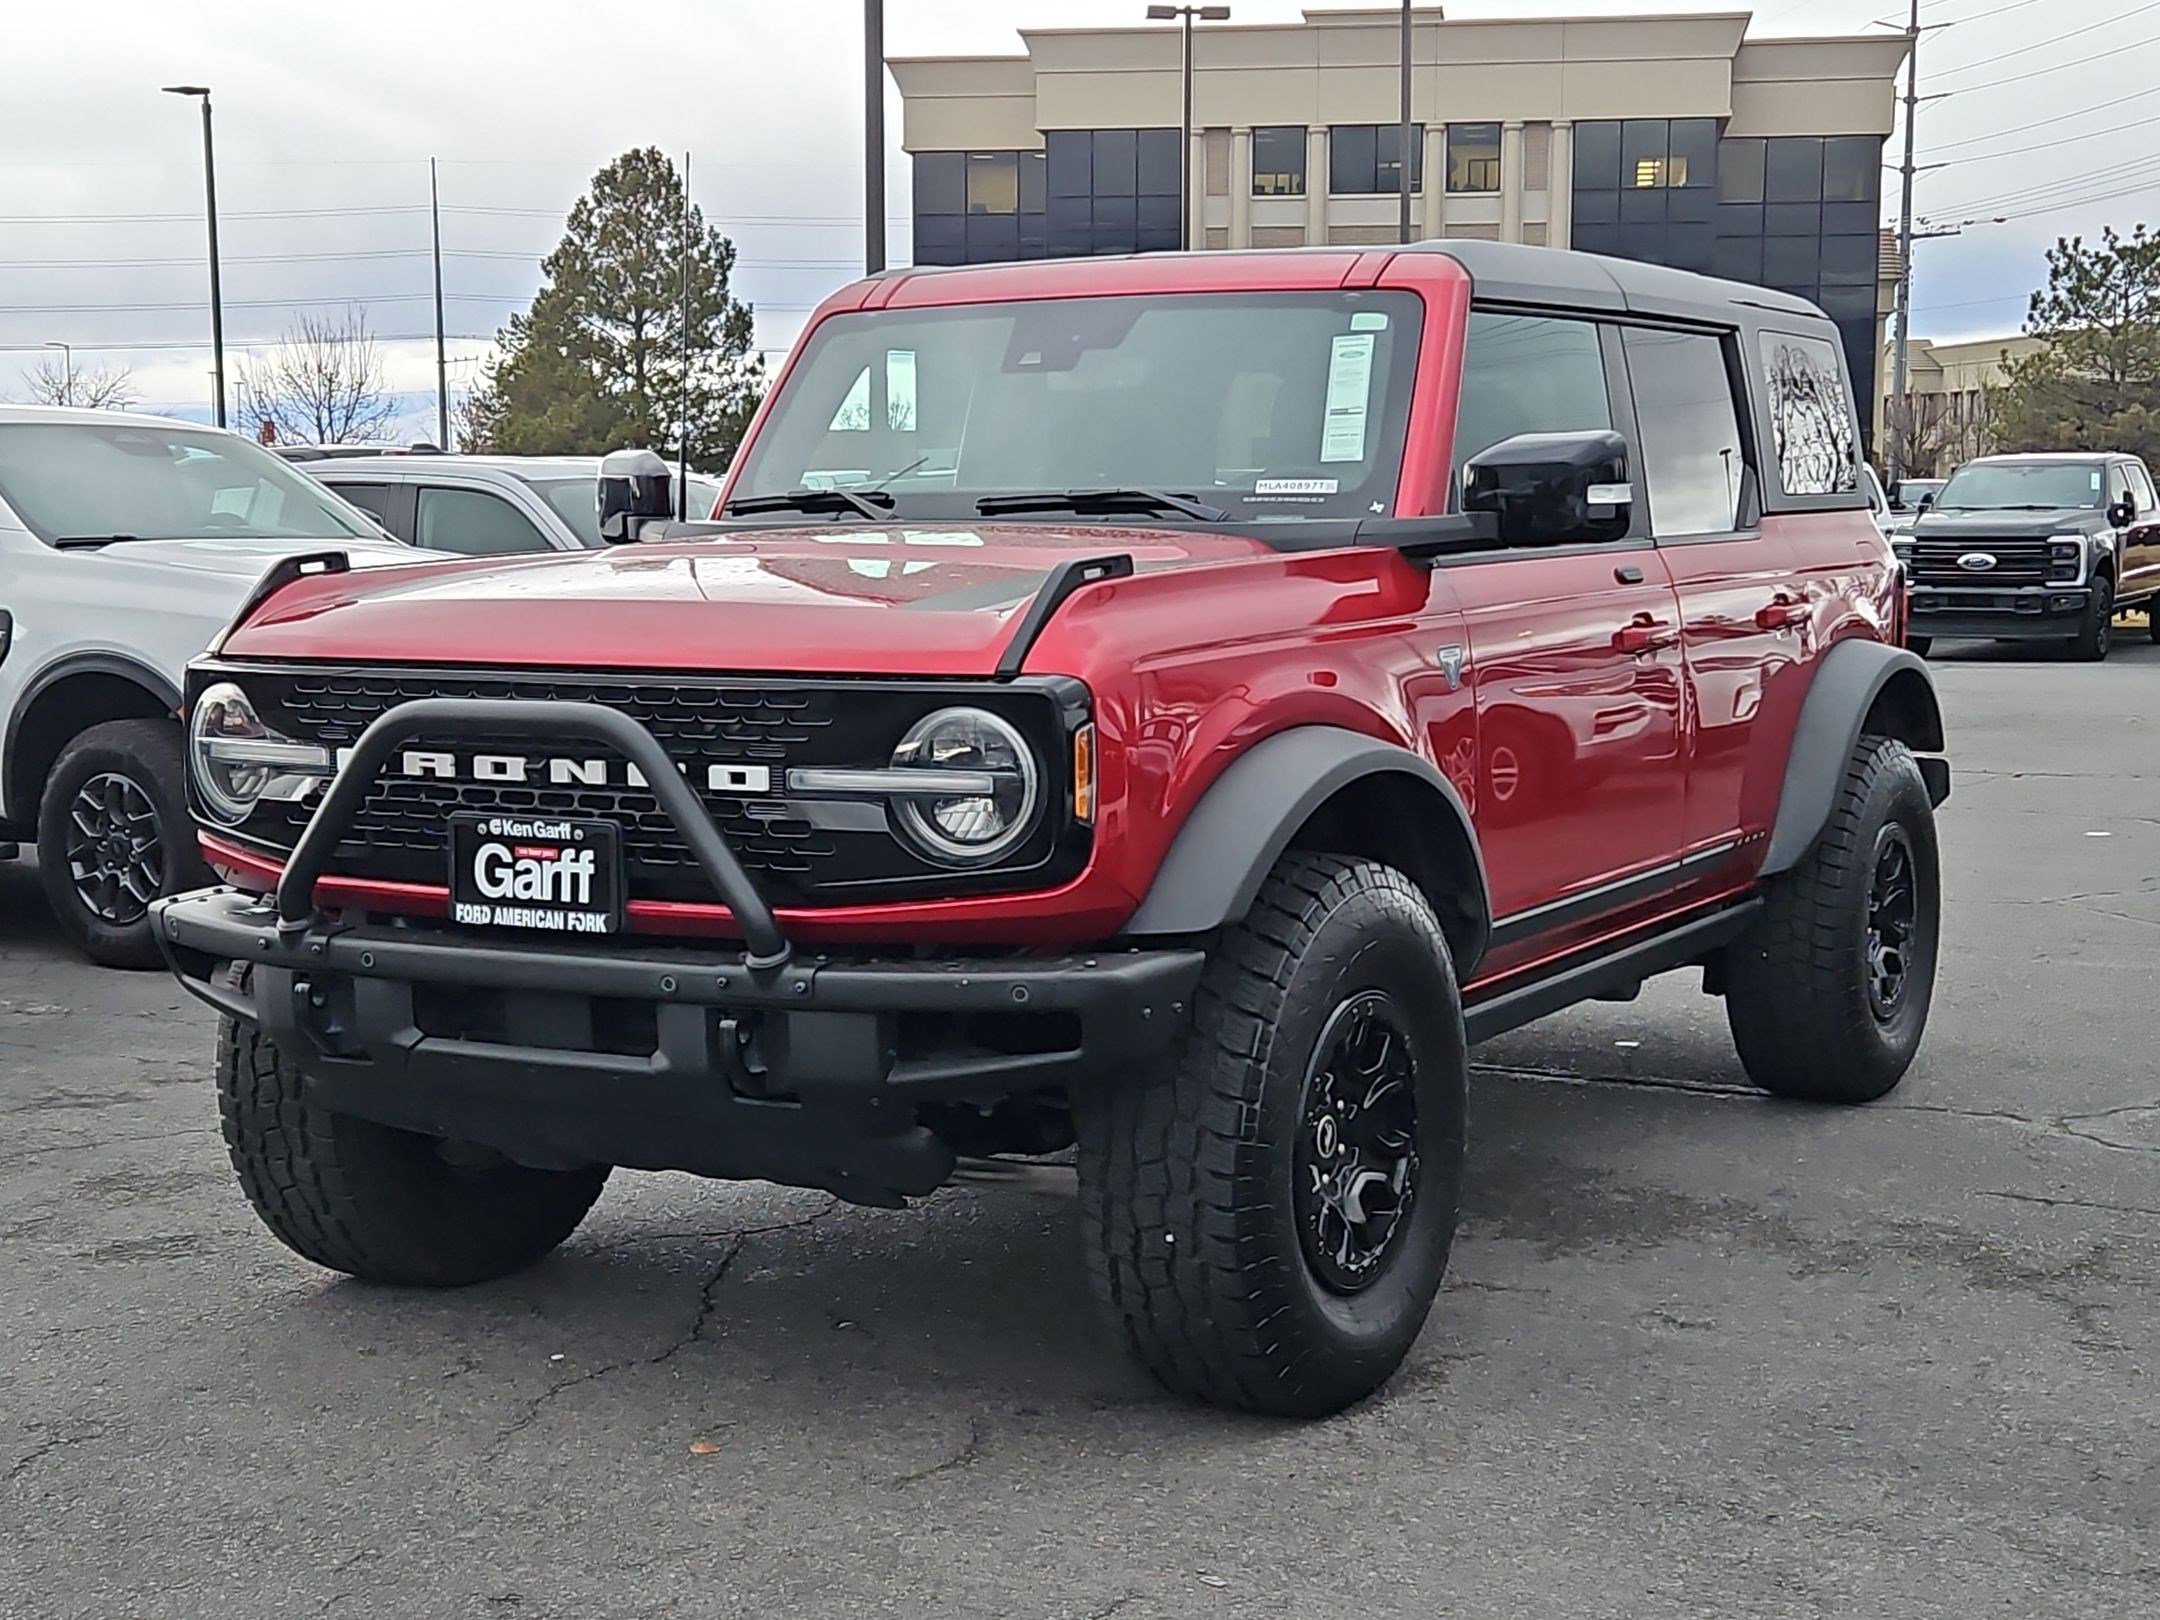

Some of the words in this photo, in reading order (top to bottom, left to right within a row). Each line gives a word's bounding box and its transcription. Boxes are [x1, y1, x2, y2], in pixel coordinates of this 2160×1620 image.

[502, 819, 533, 838] Ken
[533, 820, 571, 840] Garff
[474, 842, 596, 904] Garff
[455, 903, 491, 924] FORD
[493, 907, 565, 930] AMERICAN
[567, 913, 608, 934] FORK
